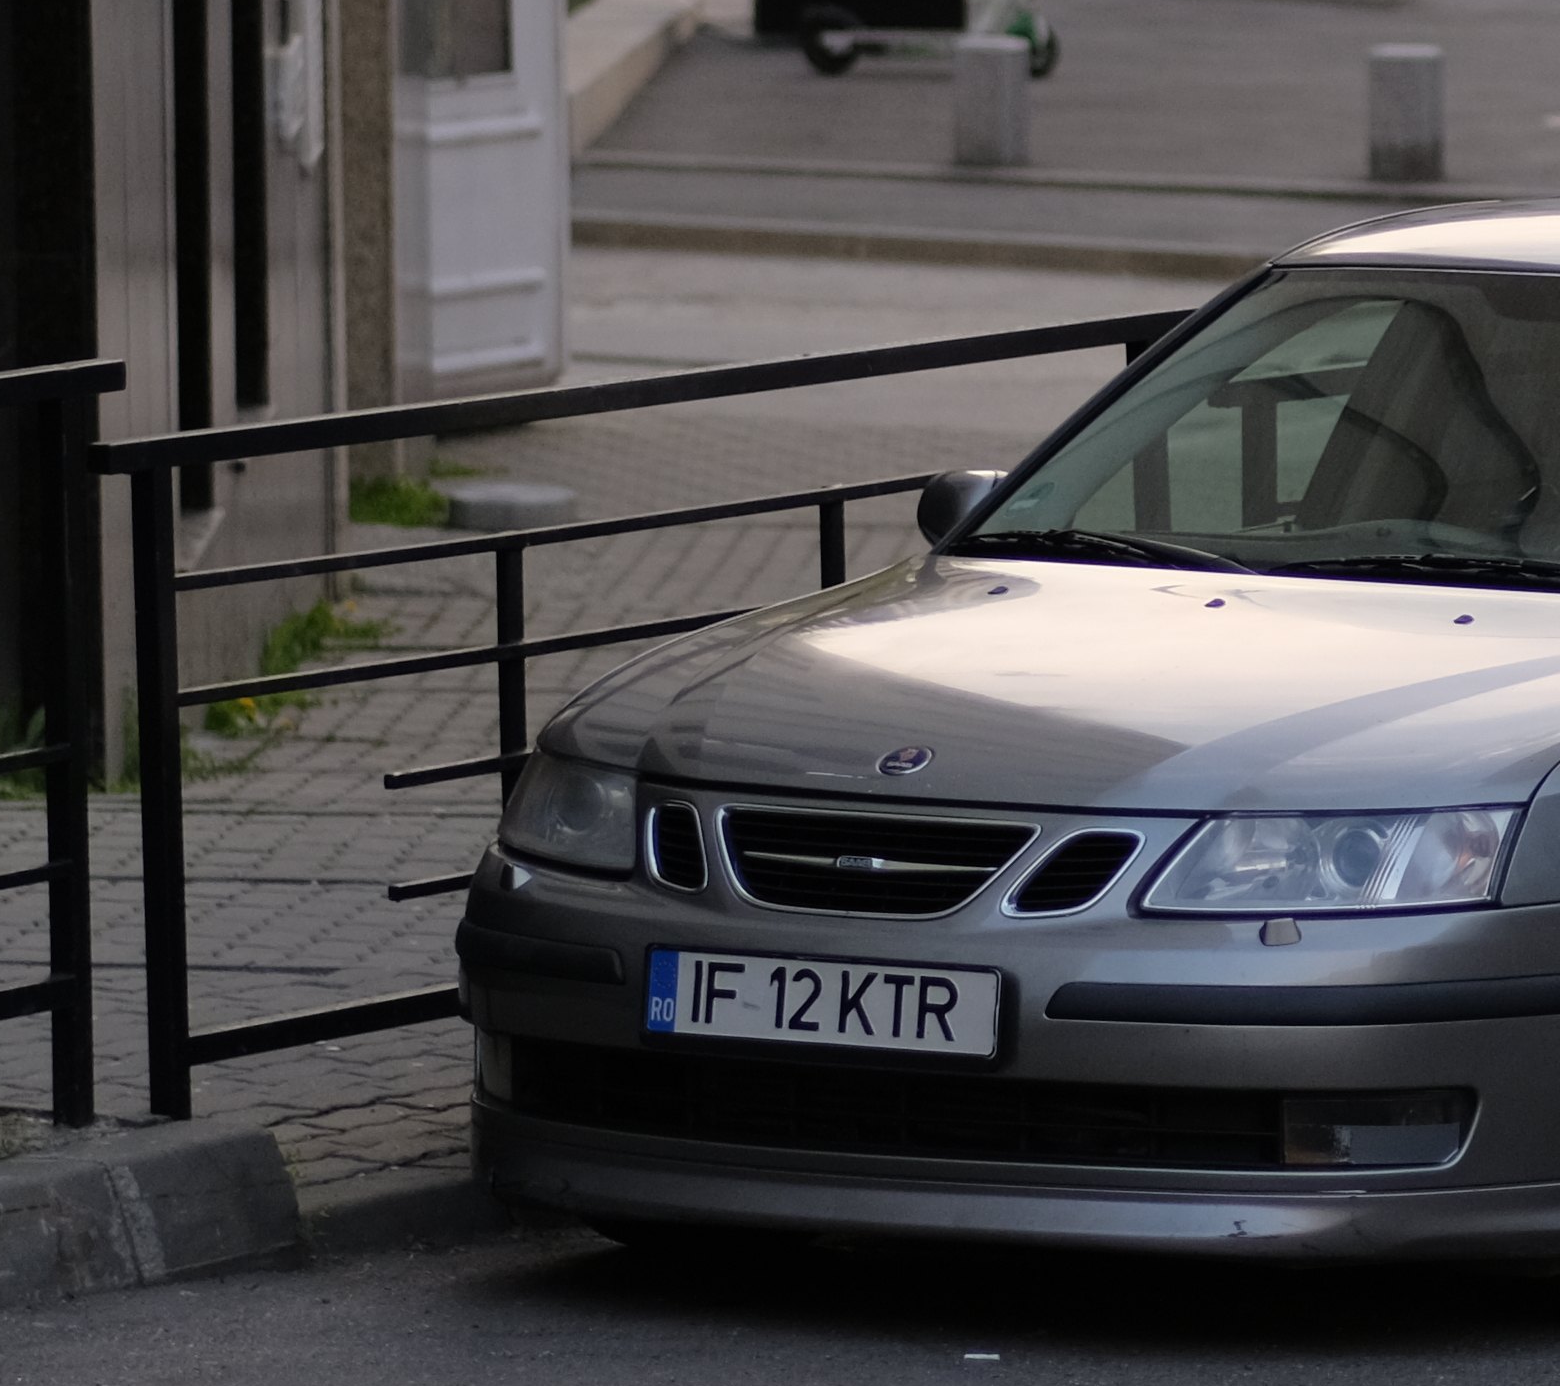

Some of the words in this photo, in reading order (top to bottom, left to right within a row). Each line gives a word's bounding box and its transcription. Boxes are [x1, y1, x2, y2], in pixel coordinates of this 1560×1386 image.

[651, 996, 674, 1022] RO
[691, 960, 746, 1024] IF
[770, 966, 823, 1032] 12
[838, 970, 959, 1042] KTR
